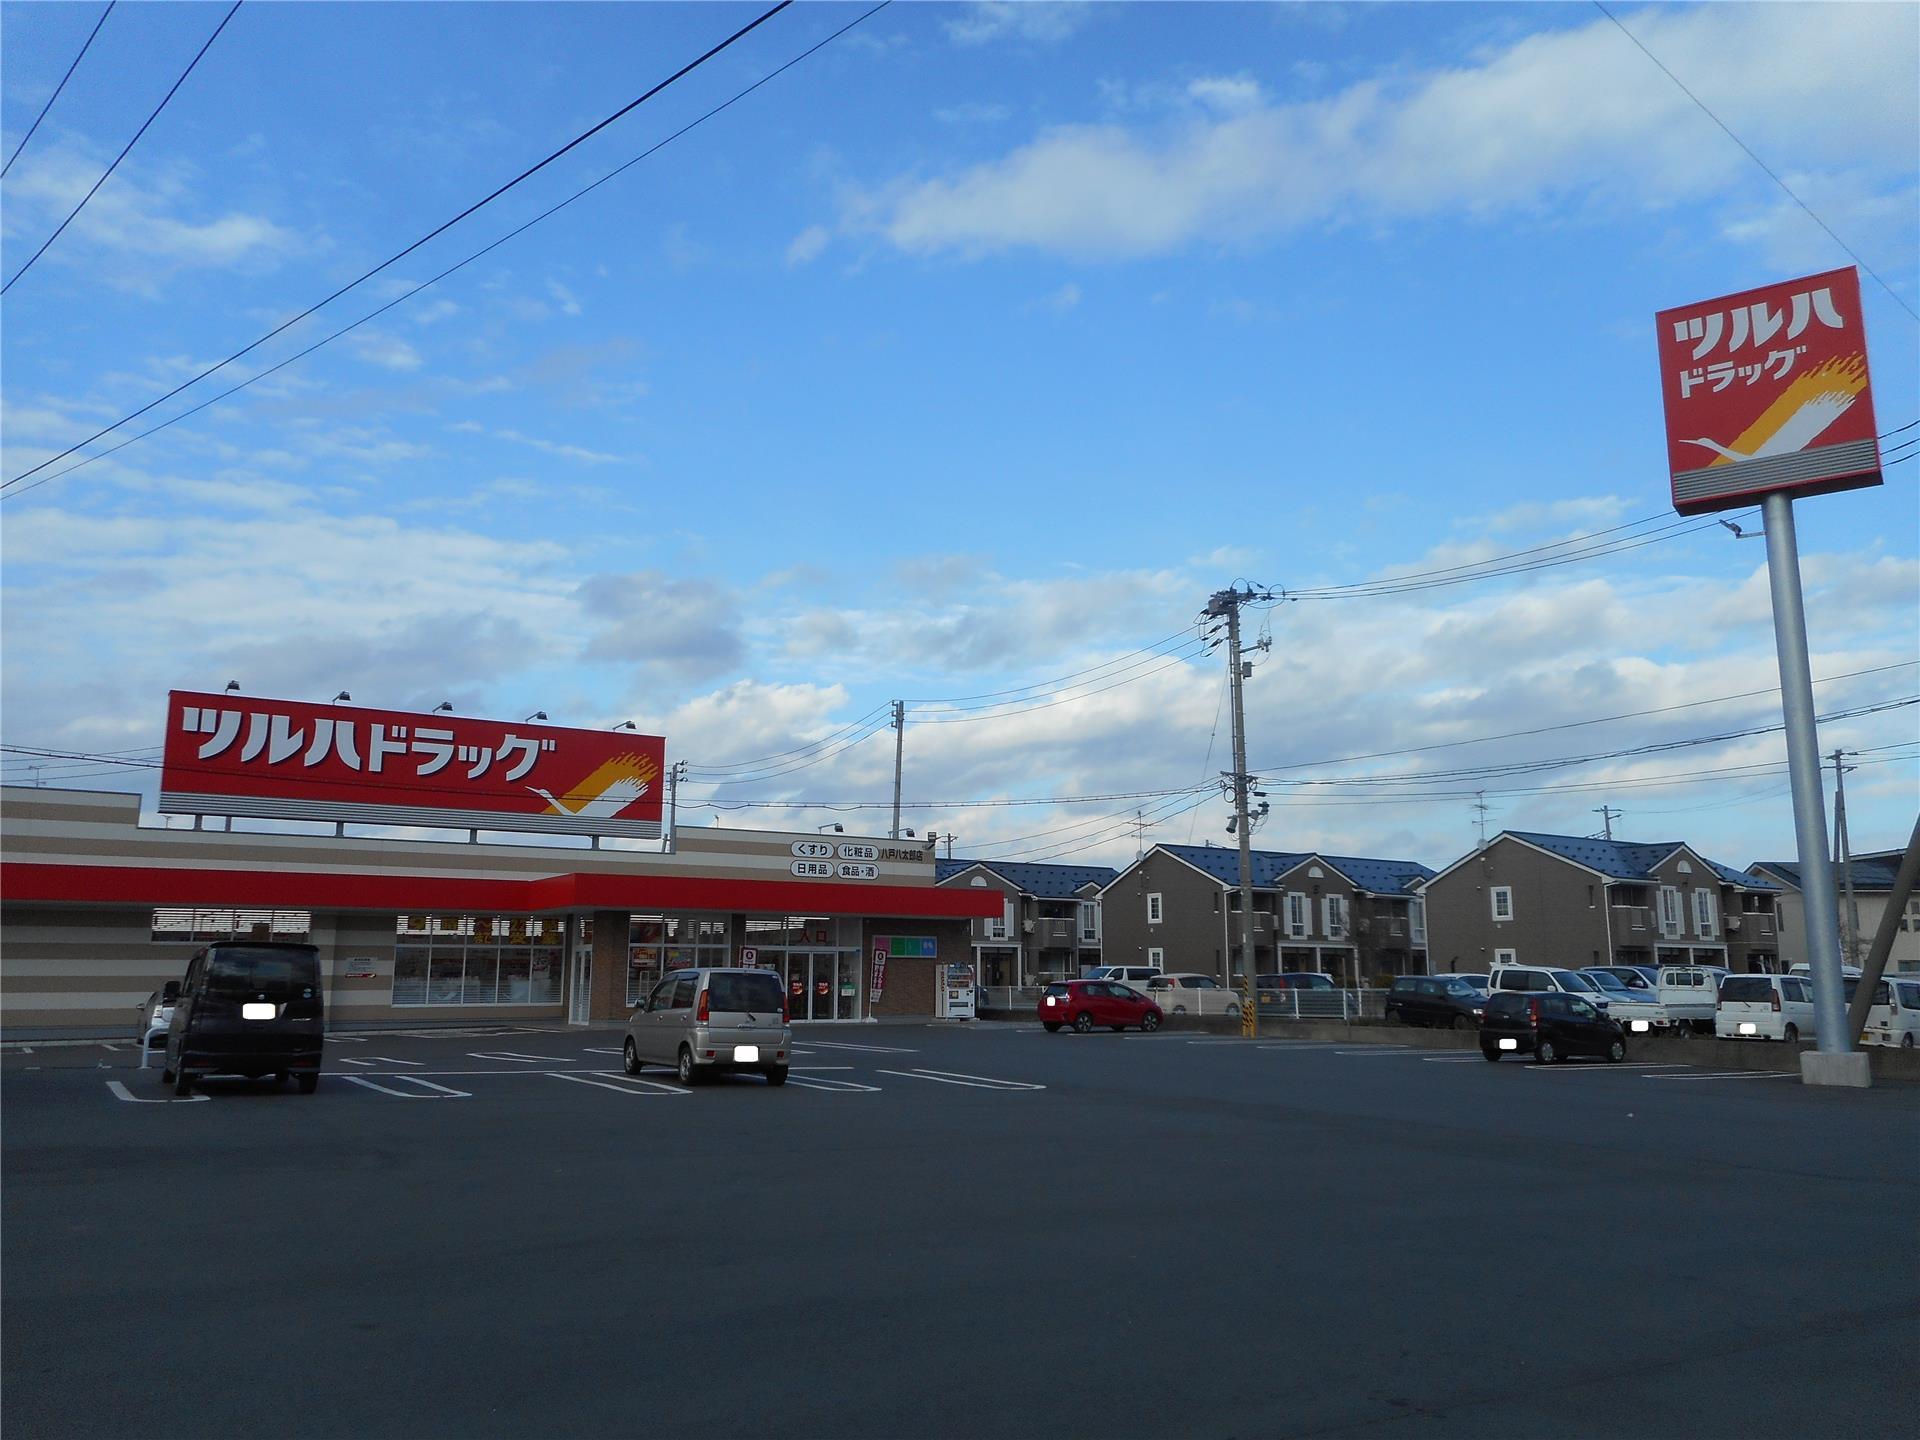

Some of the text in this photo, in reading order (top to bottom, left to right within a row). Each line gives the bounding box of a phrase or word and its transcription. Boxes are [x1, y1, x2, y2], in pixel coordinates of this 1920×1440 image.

[1673, 287, 1844, 361] ツルハ
[1680, 345, 1807, 399] ドラッグ
[182, 706, 556, 782] ツルハドラッグ
[797, 843, 828, 856] くすり
[843, 846, 873, 859] 化粧品
[797, 863, 828, 875] 日用品
